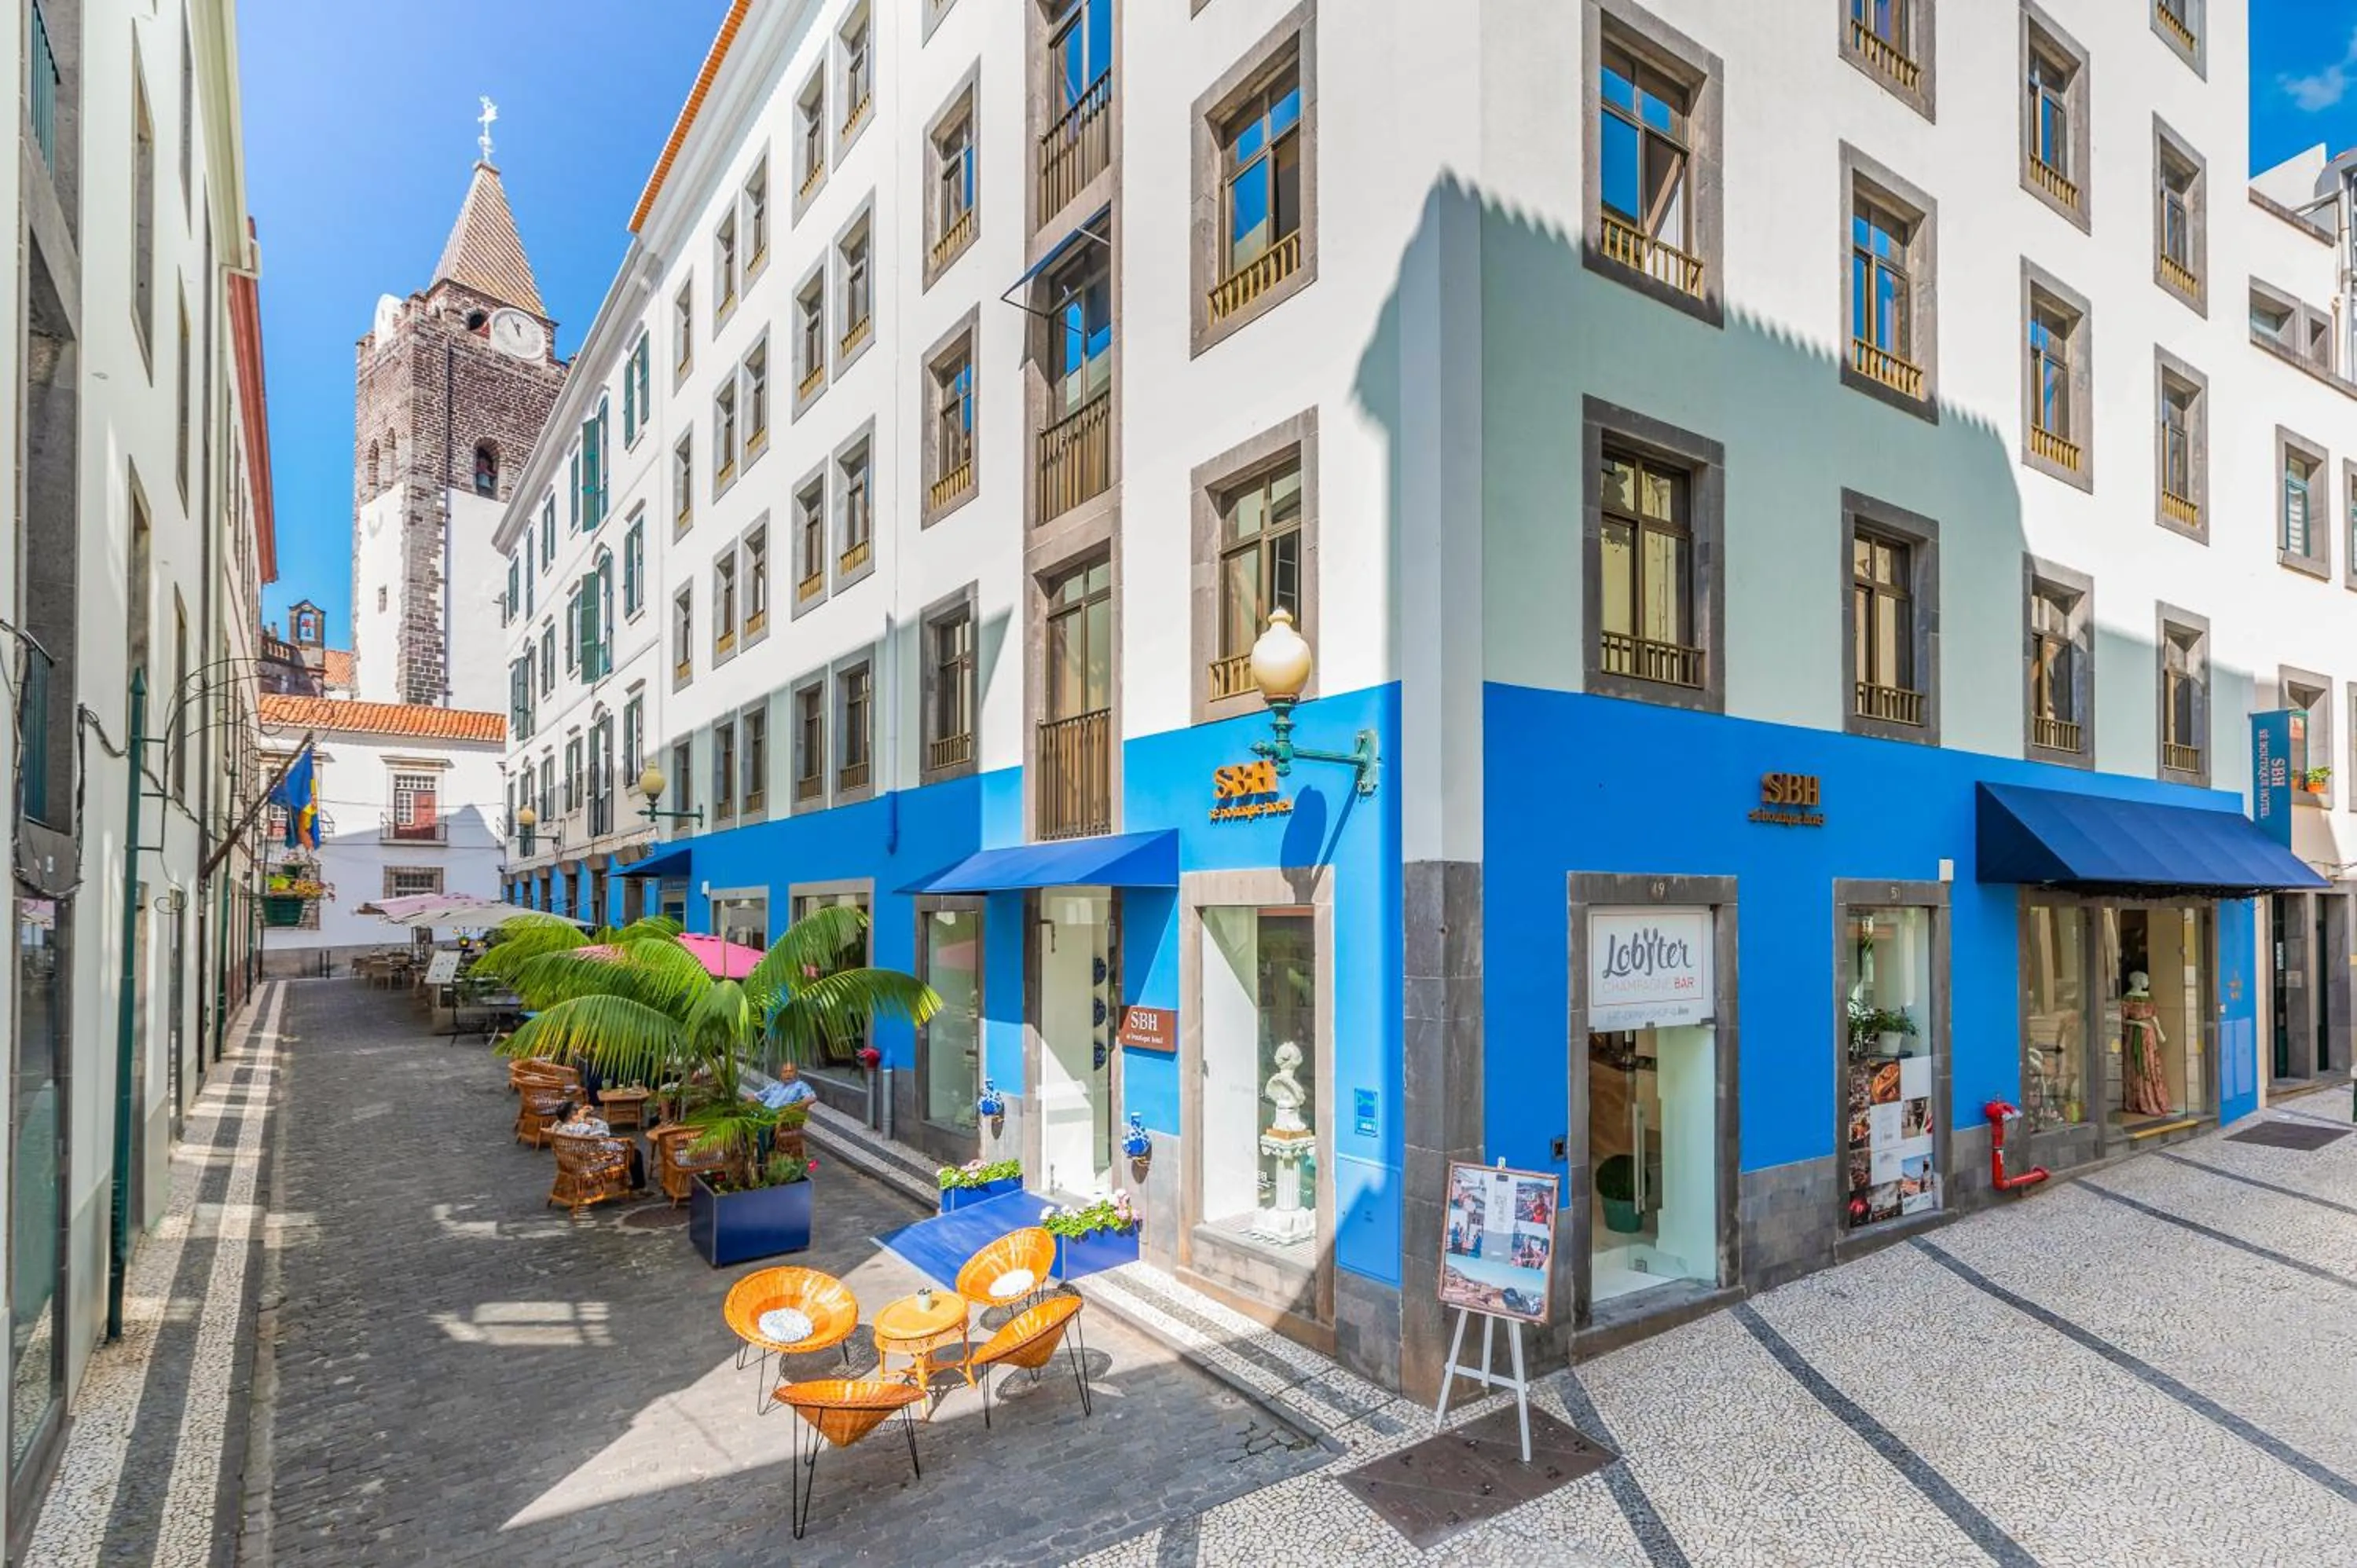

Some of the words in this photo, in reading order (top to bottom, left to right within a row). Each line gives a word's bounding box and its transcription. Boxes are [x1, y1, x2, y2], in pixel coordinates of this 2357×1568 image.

[1215, 760, 1278, 798] SBH
[2271, 757, 2286, 786] SBH
[1761, 772, 1820, 804] SBH
[2260, 789, 2270, 818] HOTEL
[1674, 976, 1695, 989] BAR
[1131, 1011, 1157, 1031] SBH
